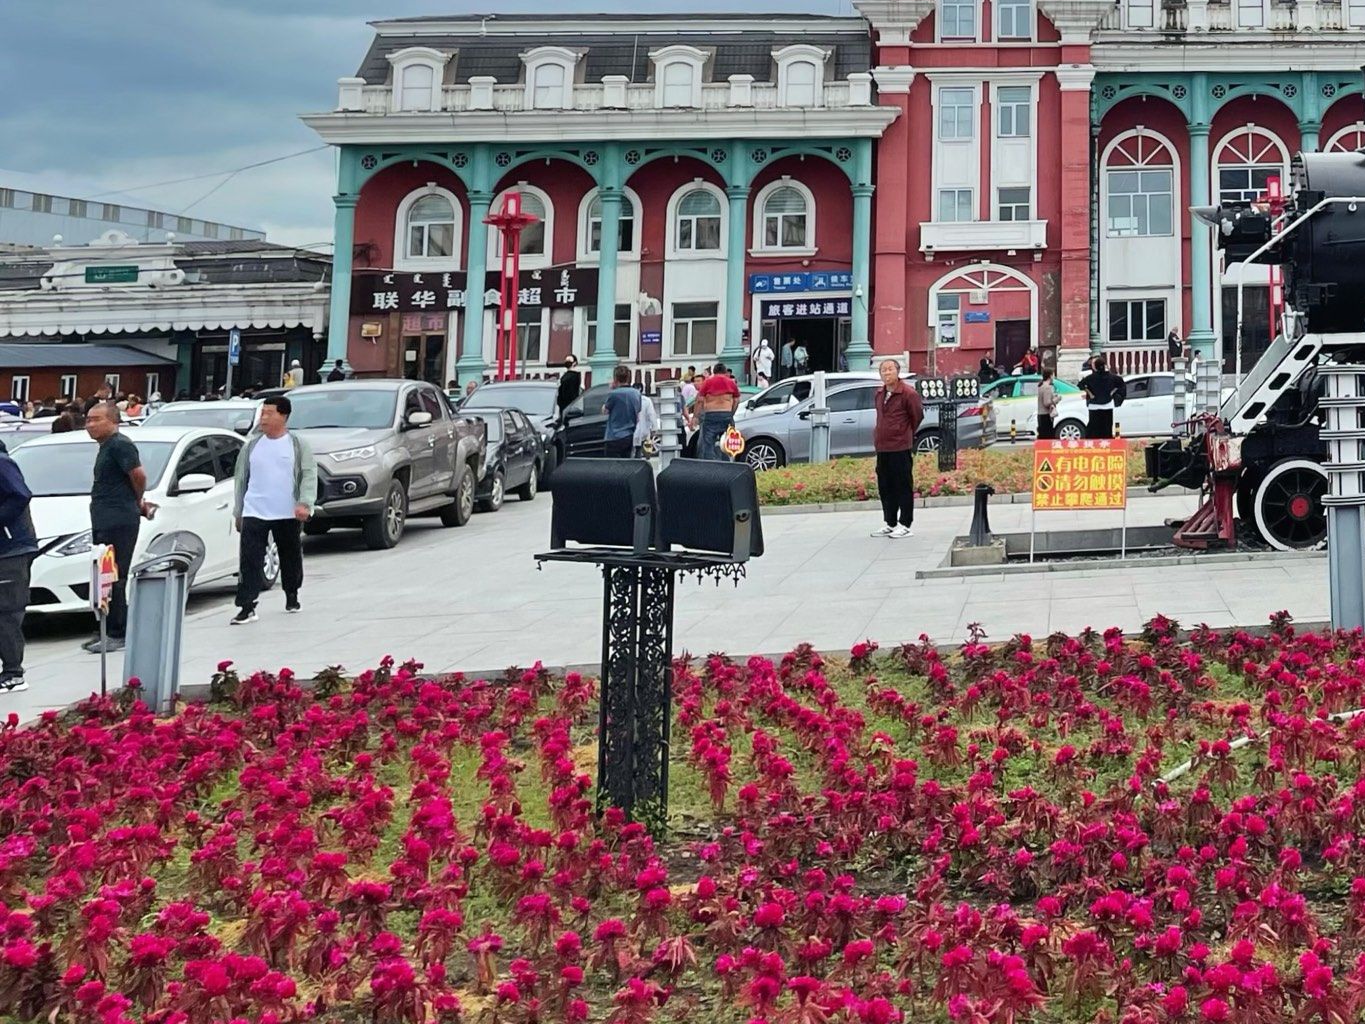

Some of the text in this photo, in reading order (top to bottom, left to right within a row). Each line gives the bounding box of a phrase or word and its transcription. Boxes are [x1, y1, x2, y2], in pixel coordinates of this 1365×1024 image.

[372, 287, 578, 310] 联华副食超市
[768, 302, 849, 317] 旅客进站通道
[402, 314, 446, 332] 超市
[1055, 455, 1123, 473] 有电危险
[1055, 474, 1123, 491] 请勿触摸
[1036, 492, 1123, 507] 禁止攀爬通过
